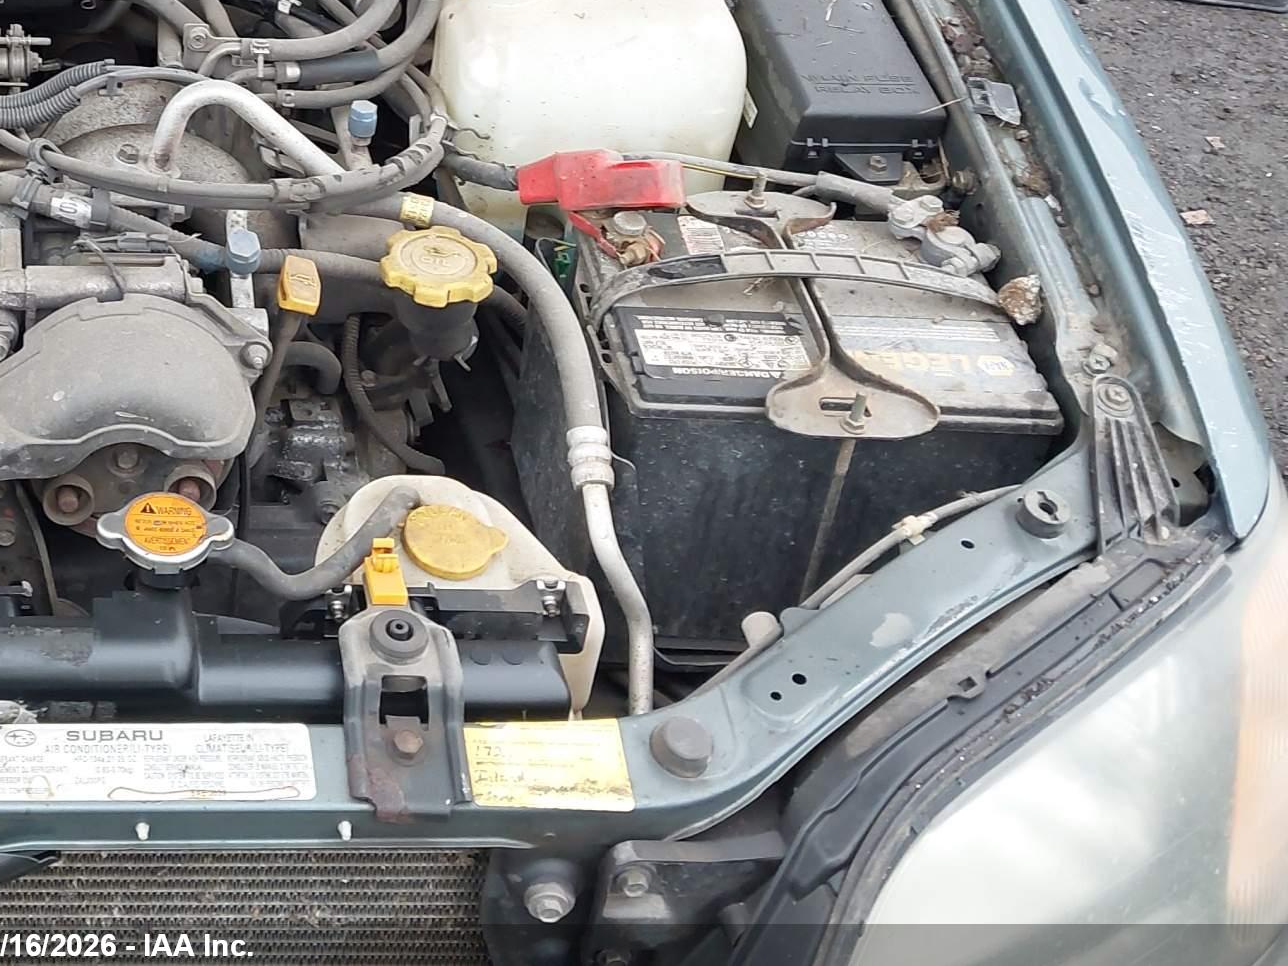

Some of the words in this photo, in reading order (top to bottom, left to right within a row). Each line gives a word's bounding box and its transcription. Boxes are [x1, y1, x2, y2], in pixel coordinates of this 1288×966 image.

[863, 75, 914, 83] FUSE
[814, 86, 871, 95] RELAY
[878, 87, 920, 95] BOX
[156, 506, 192, 516] WARNING
[66, 730, 163, 742] SUBARU
[45, 745, 61, 753] AIR
